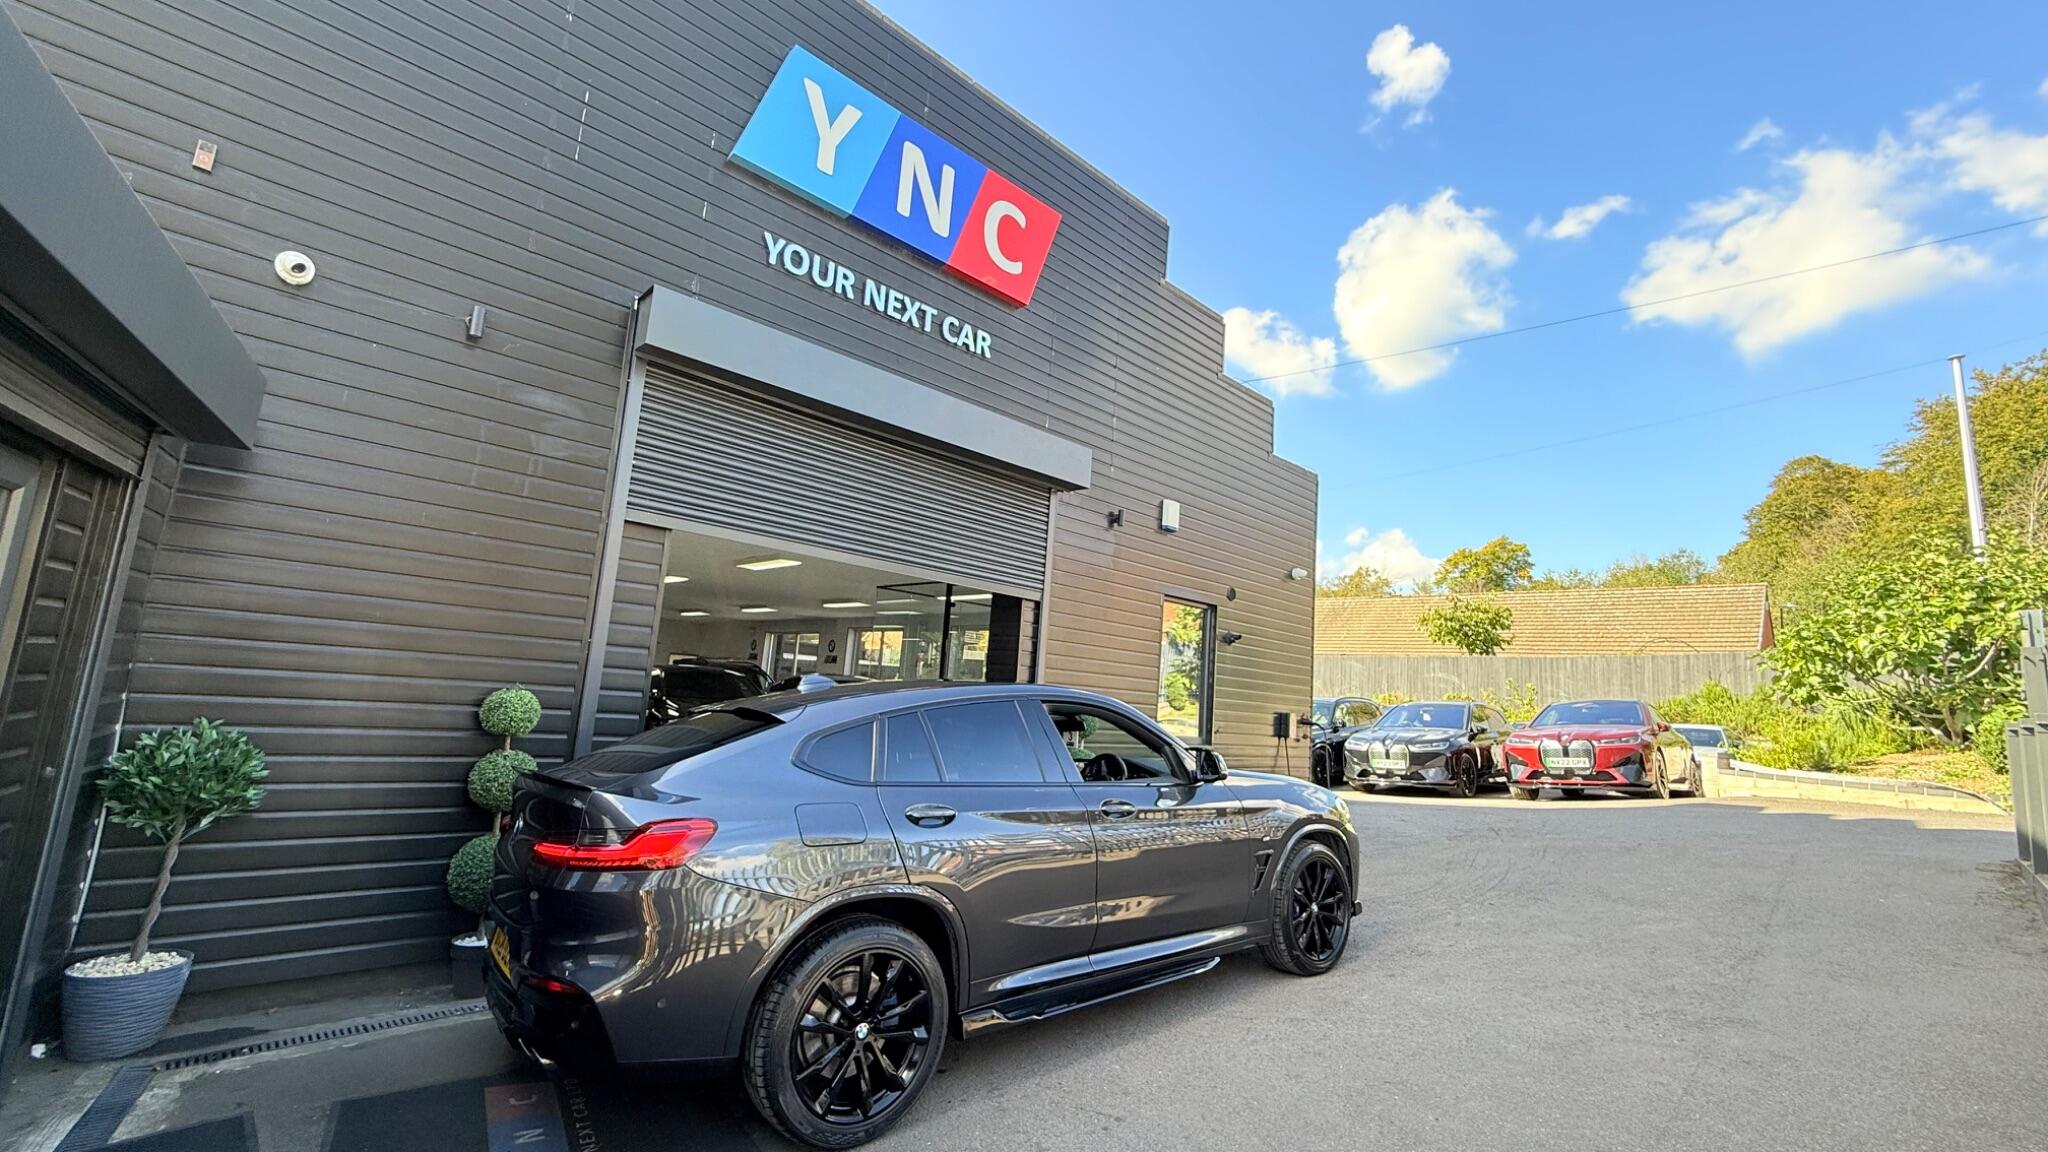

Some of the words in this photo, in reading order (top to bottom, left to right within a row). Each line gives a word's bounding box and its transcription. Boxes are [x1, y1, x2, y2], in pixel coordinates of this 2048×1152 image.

[764, 231, 855, 299] YOUR
[864, 278, 938, 333] NEXT
[942, 316, 992, 359] CAR
